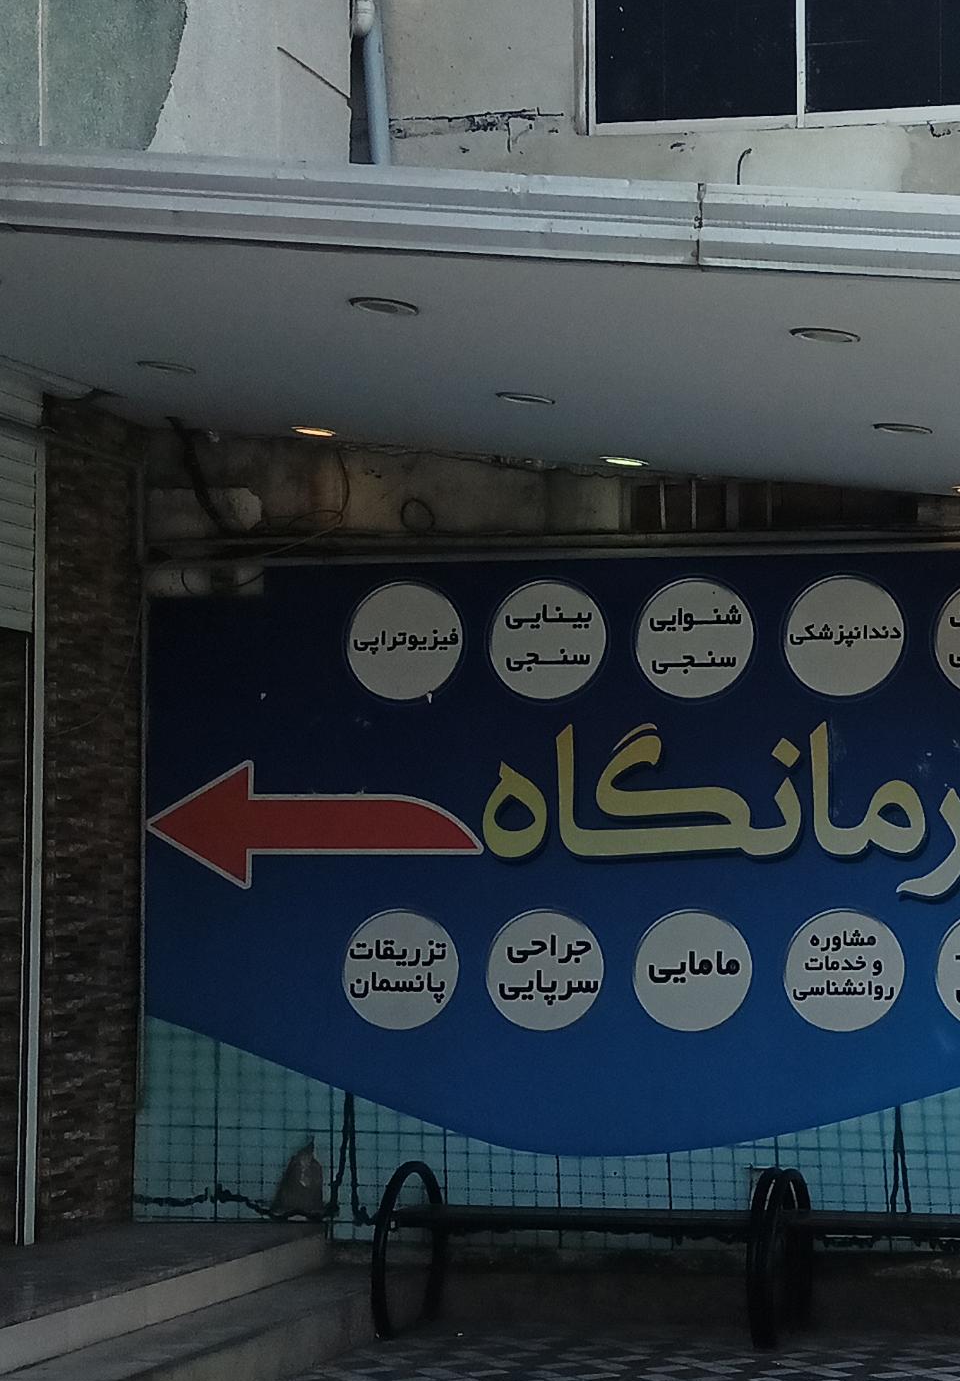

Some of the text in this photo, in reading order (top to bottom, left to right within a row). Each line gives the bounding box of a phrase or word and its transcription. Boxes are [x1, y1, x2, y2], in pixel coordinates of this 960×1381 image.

[504, 604, 593, 629] بینایی
[649, 605, 741, 632] شنوایی
[353, 627, 459, 654] فیزیوتراپی
[789, 623, 902, 647] دندانپزشکی
[505, 648, 590, 671] سنجی
[651, 650, 737, 674] سنجی
[348, 938, 447, 966] تزریقات
[506, 934, 592, 964] جراحی
[809, 929, 877, 952] مشاوره
[648, 950, 741, 984] مامایی
[804, 955, 883, 976] و خدمات
[348, 971, 446, 1003] پانسمان
[499, 969, 599, 1005] سرپایی
[792, 979, 895, 1001] روانشناسی
